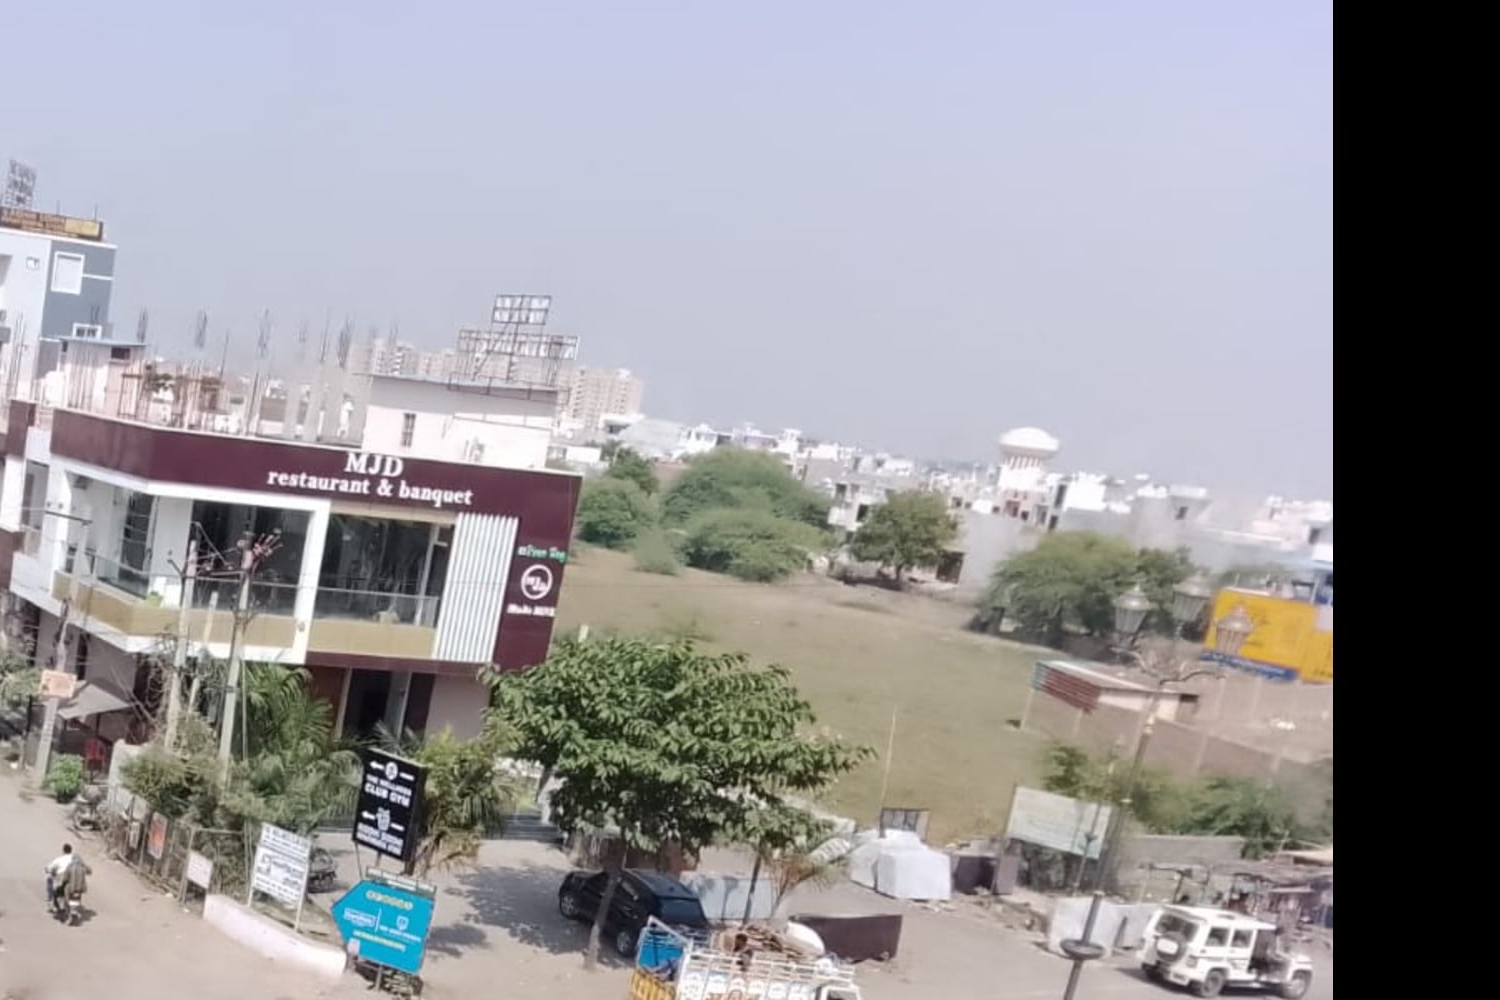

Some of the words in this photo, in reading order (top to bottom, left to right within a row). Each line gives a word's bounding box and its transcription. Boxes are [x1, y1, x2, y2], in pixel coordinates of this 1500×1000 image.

[344, 452, 403, 478] MJD
[266, 470, 370, 494] restaurant
[377, 478, 394, 497] &
[399, 480, 473, 507] banquet
